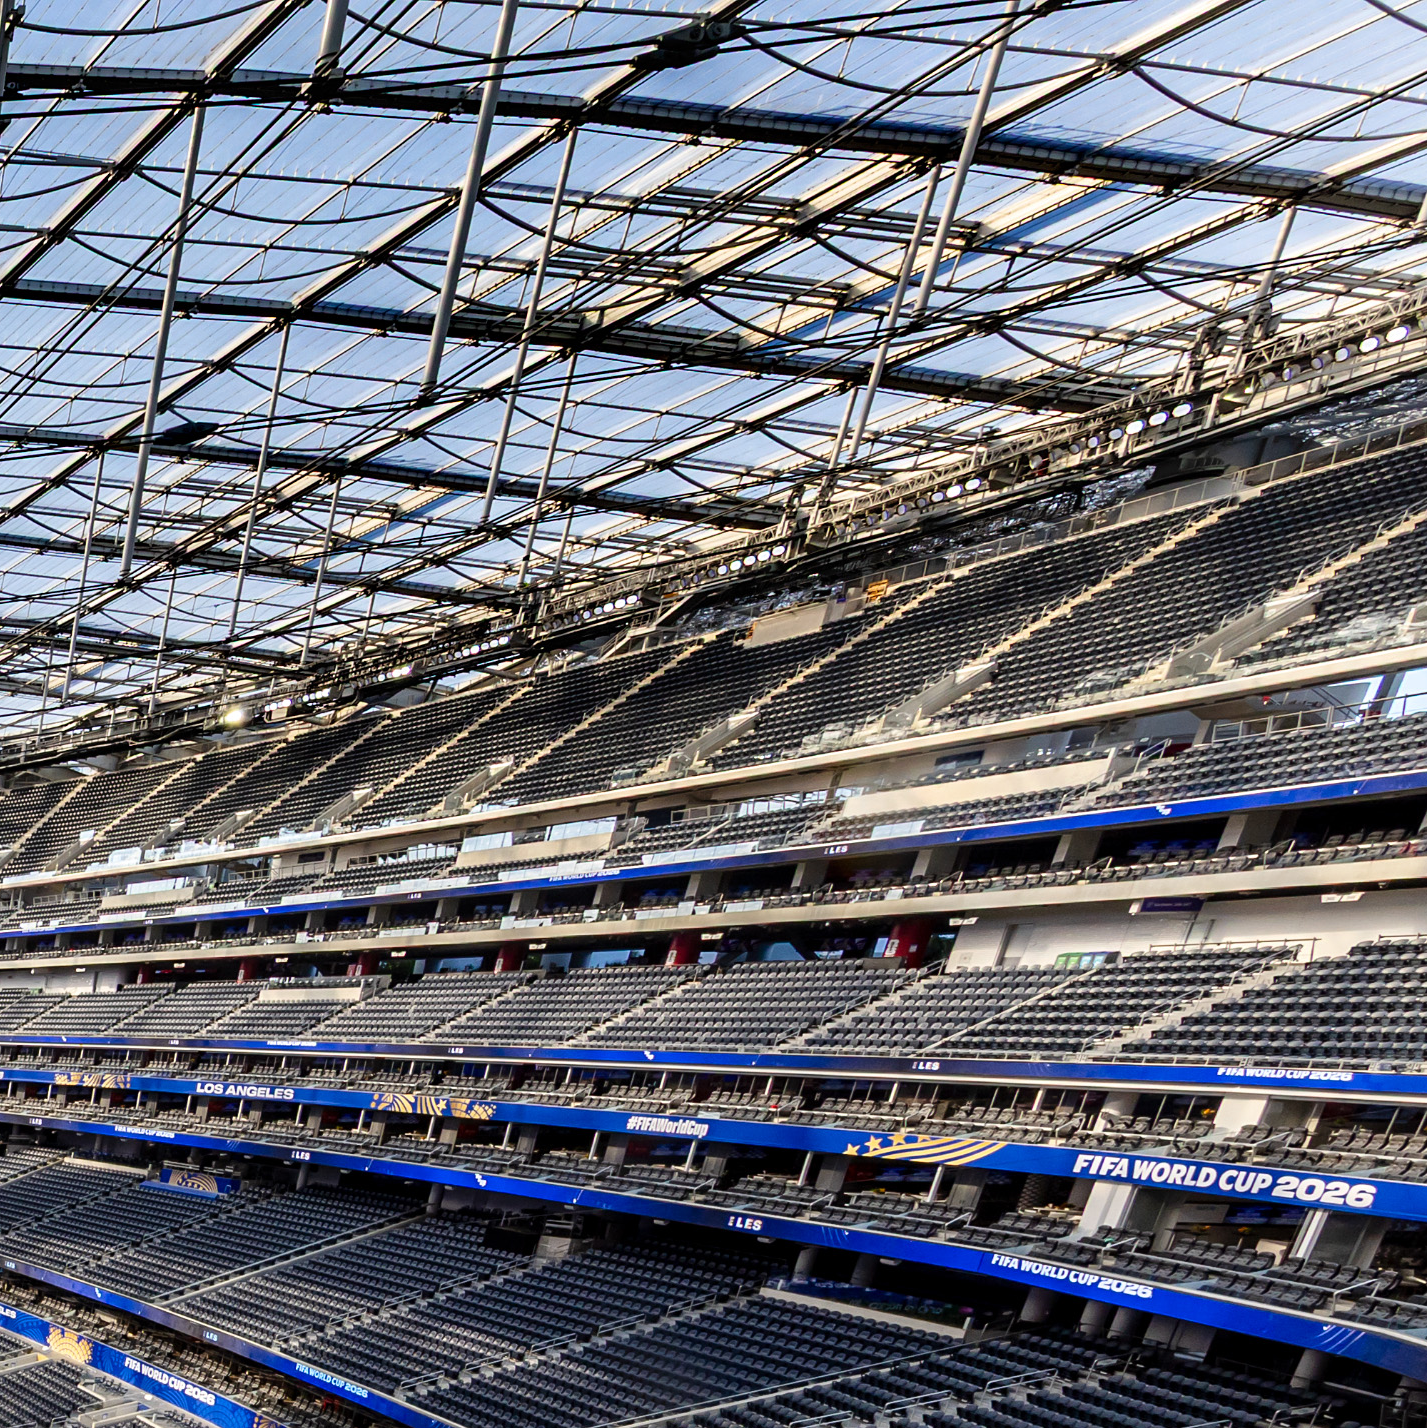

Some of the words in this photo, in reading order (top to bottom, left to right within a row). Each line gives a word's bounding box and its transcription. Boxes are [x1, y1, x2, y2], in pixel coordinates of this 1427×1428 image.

[196, 1082, 224, 1094] LOS
[225, 1084, 294, 1100] ANGELES
[1217, 1067, 1245, 1076] FIFA
[1246, 1069, 1285, 1078] WORLD
[1286, 1070, 1309, 1079] CUP
[1309, 1071, 1353, 1081] 2026
[626, 1116, 709, 1139] #FIFAWorldCup
[1072, 1153, 1129, 1177] FIFA
[1126, 1160, 1210, 1188] WORLD
[1218, 1168, 1272, 1194] CUP
[1270, 1174, 1378, 1208] 2026
[991, 1254, 1020, 1270] FIFA
[1021, 1258, 1069, 1279] WORLD
[1069, 1268, 1100, 1285] CUP
[1098, 1276, 1153, 1299] 2026
[125, 1357, 141, 1373] FIFA
[141, 1364, 169, 1386] WORLD
[169, 1375, 185, 1391] CUP
[185, 1382, 216, 1406] 2026
[296, 1362, 309, 1376] FIFA
[308, 1366, 332, 1384] WORLD
[332, 1376, 345, 1388] CUP
[345, 1380, 369, 1398] 2026
